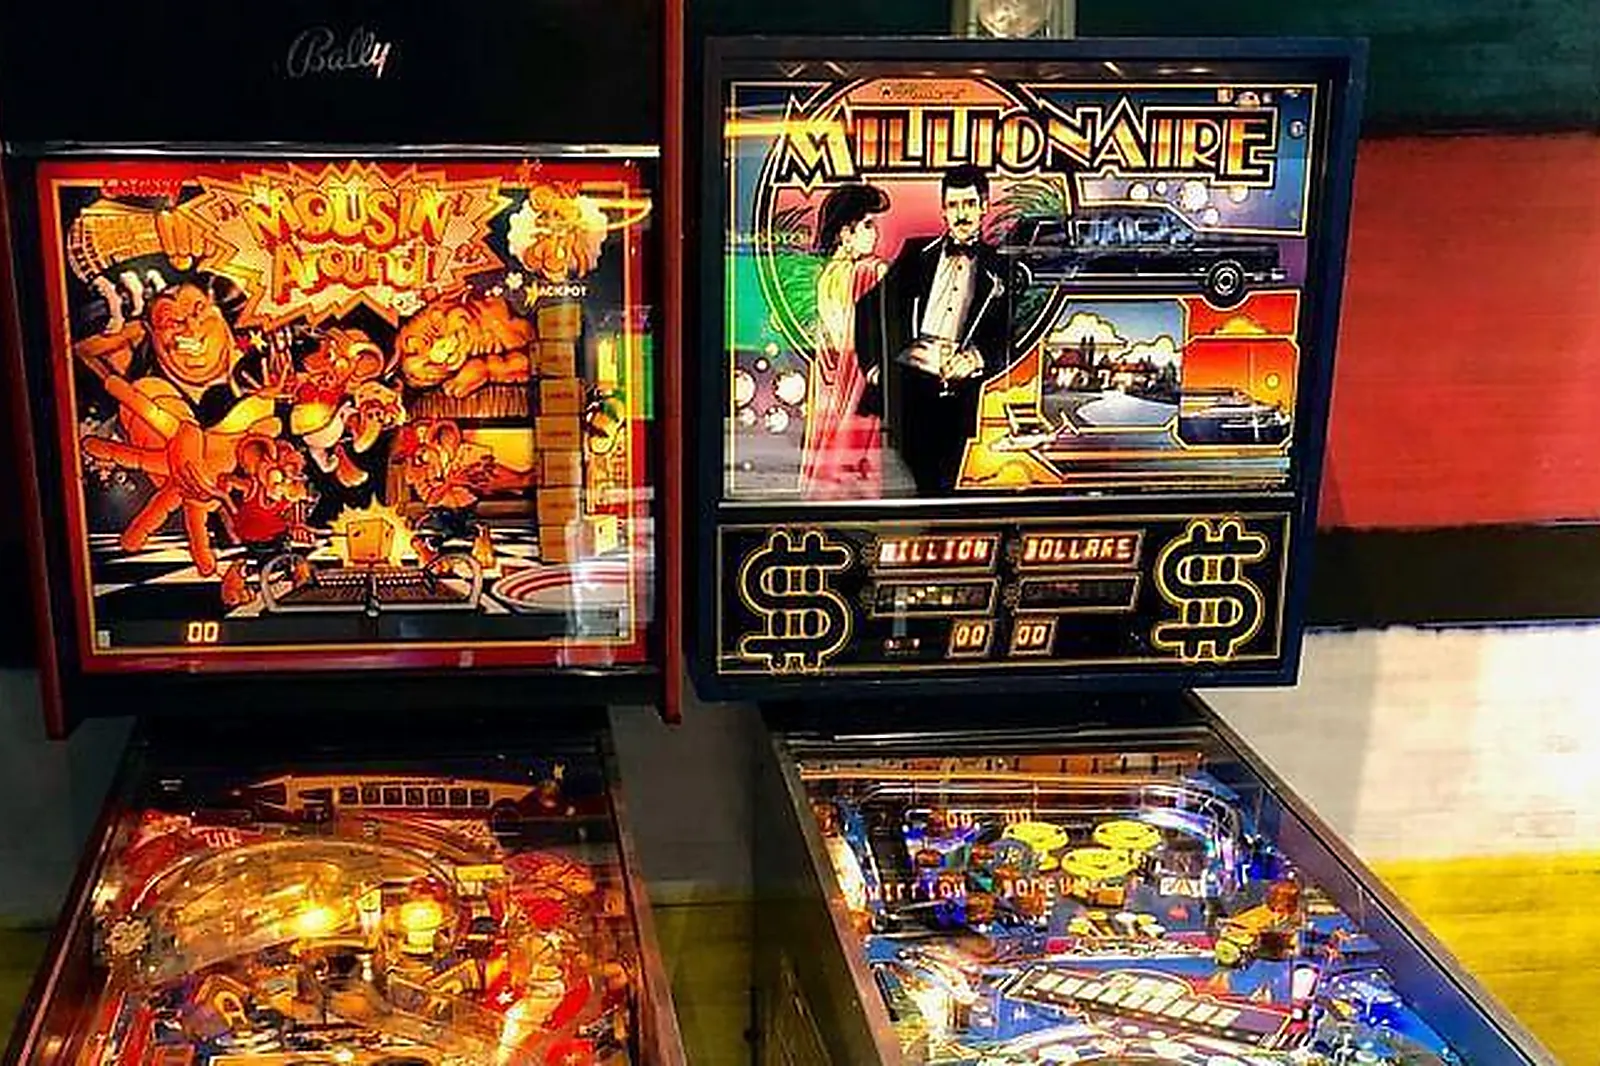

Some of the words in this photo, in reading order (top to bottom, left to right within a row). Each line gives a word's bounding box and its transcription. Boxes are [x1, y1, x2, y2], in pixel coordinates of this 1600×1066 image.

[286, 26, 392, 78] Bally
[774, 104, 1269, 184] MILLIONAIRE
[187, 621, 219, 643] 00
[956, 624, 986, 647] 00
[1017, 624, 1047, 647] 00
